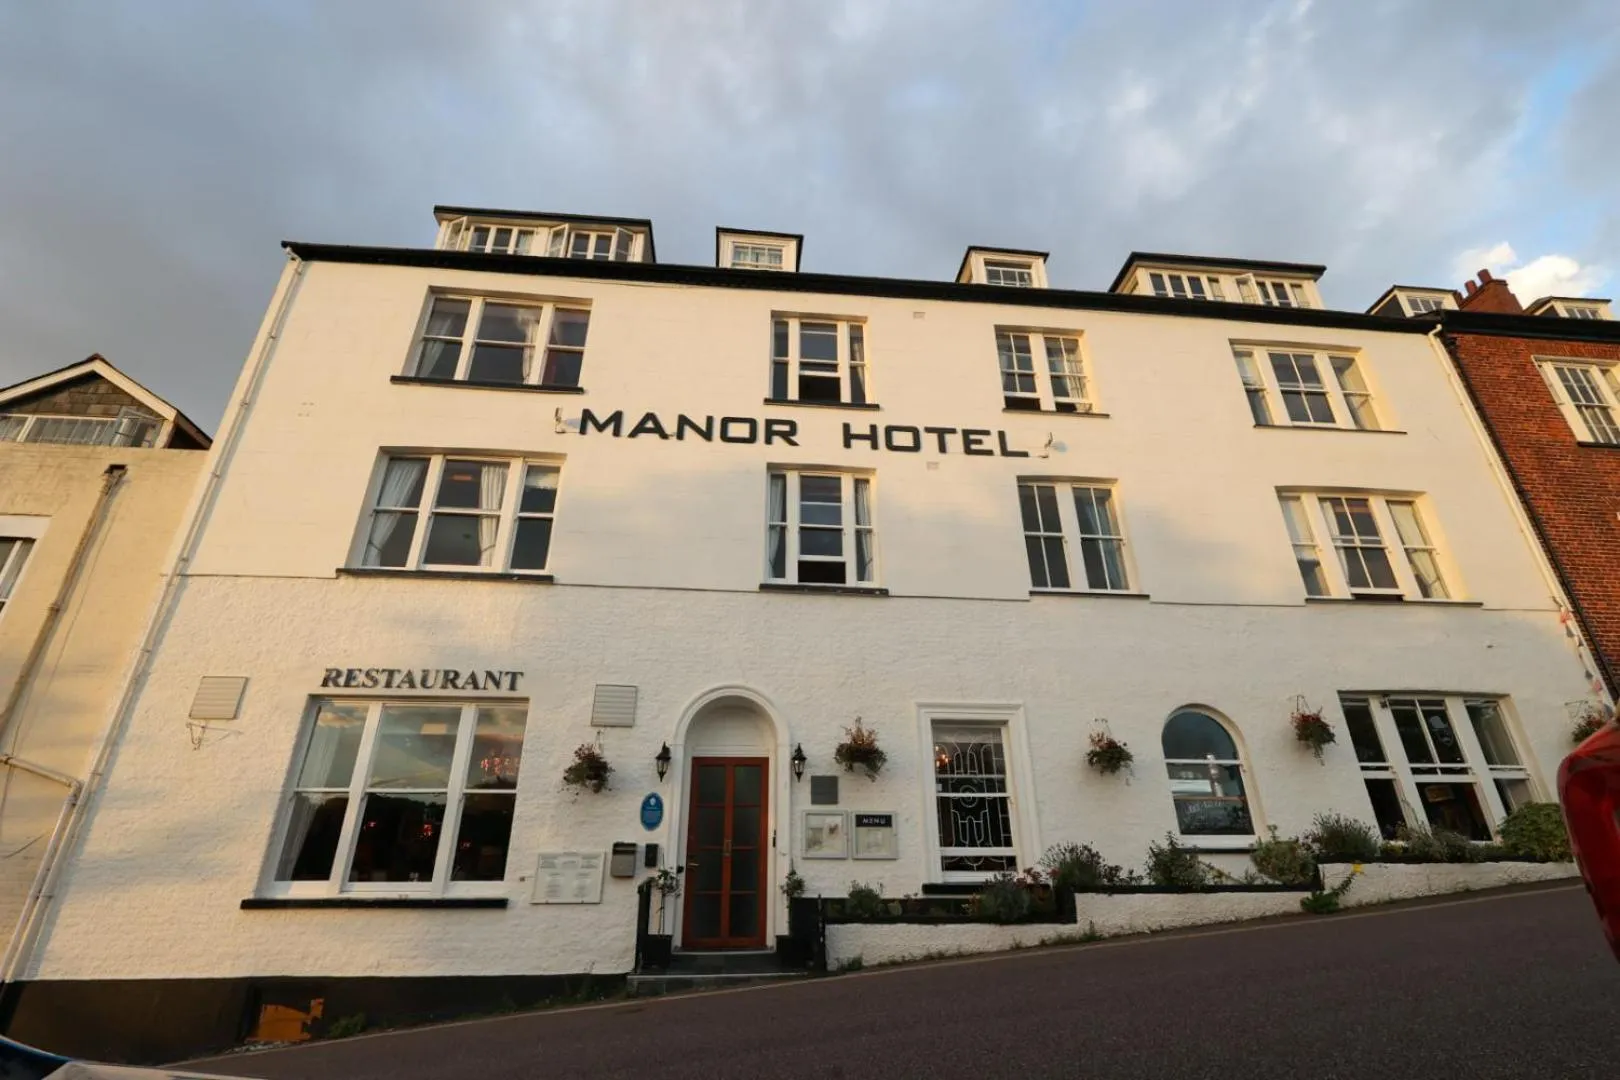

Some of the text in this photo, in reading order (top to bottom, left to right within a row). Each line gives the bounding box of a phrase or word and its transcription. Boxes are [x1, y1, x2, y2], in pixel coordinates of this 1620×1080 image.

[579, 408, 1029, 458] MANOR HOTEL
[320, 667, 525, 692] RESTAURANT
